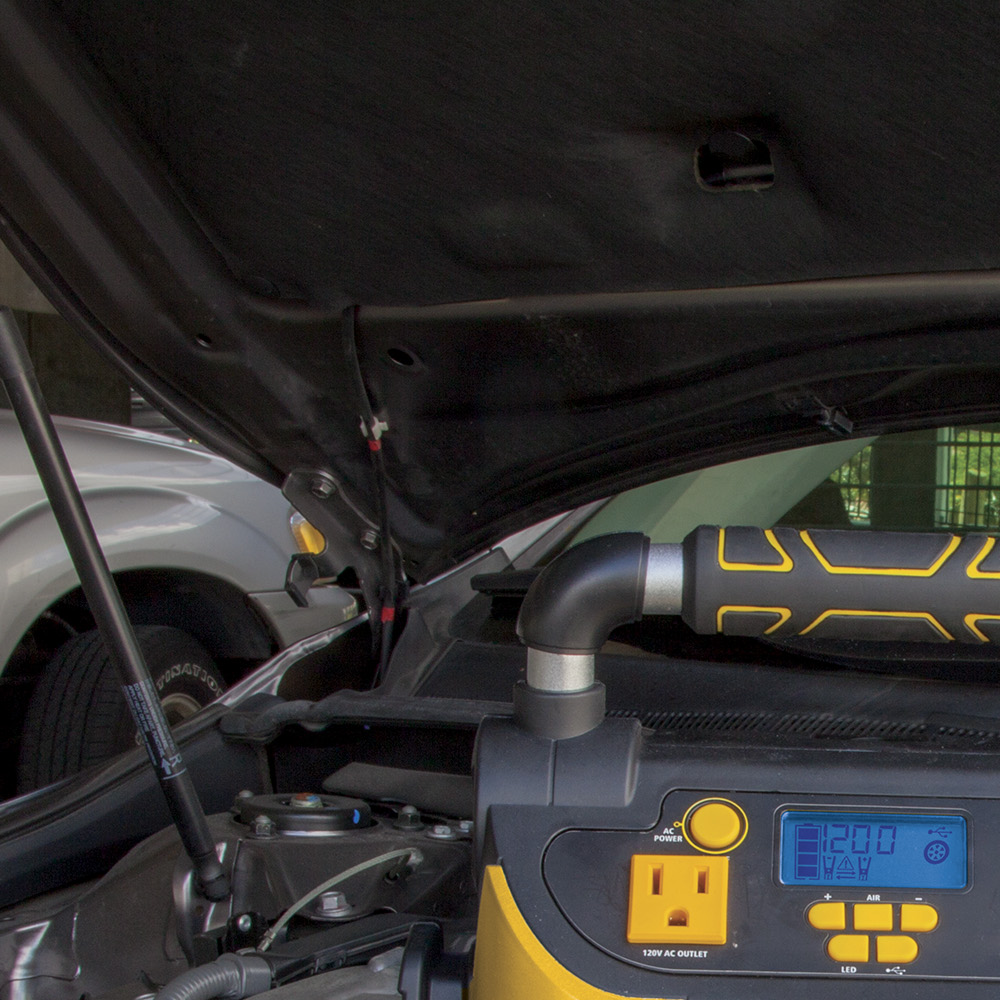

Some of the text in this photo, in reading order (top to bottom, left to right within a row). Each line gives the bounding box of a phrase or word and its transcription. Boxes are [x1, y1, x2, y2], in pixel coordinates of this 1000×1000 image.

[663, 827, 674, 835] AC
[653, 835, 683, 843] POWER
[823, 824, 897, 855] 1200
[866, 894, 881, 902] AIR
[642, 949, 708, 958] 120V AC OUTLET
[841, 966, 857, 974] LED
